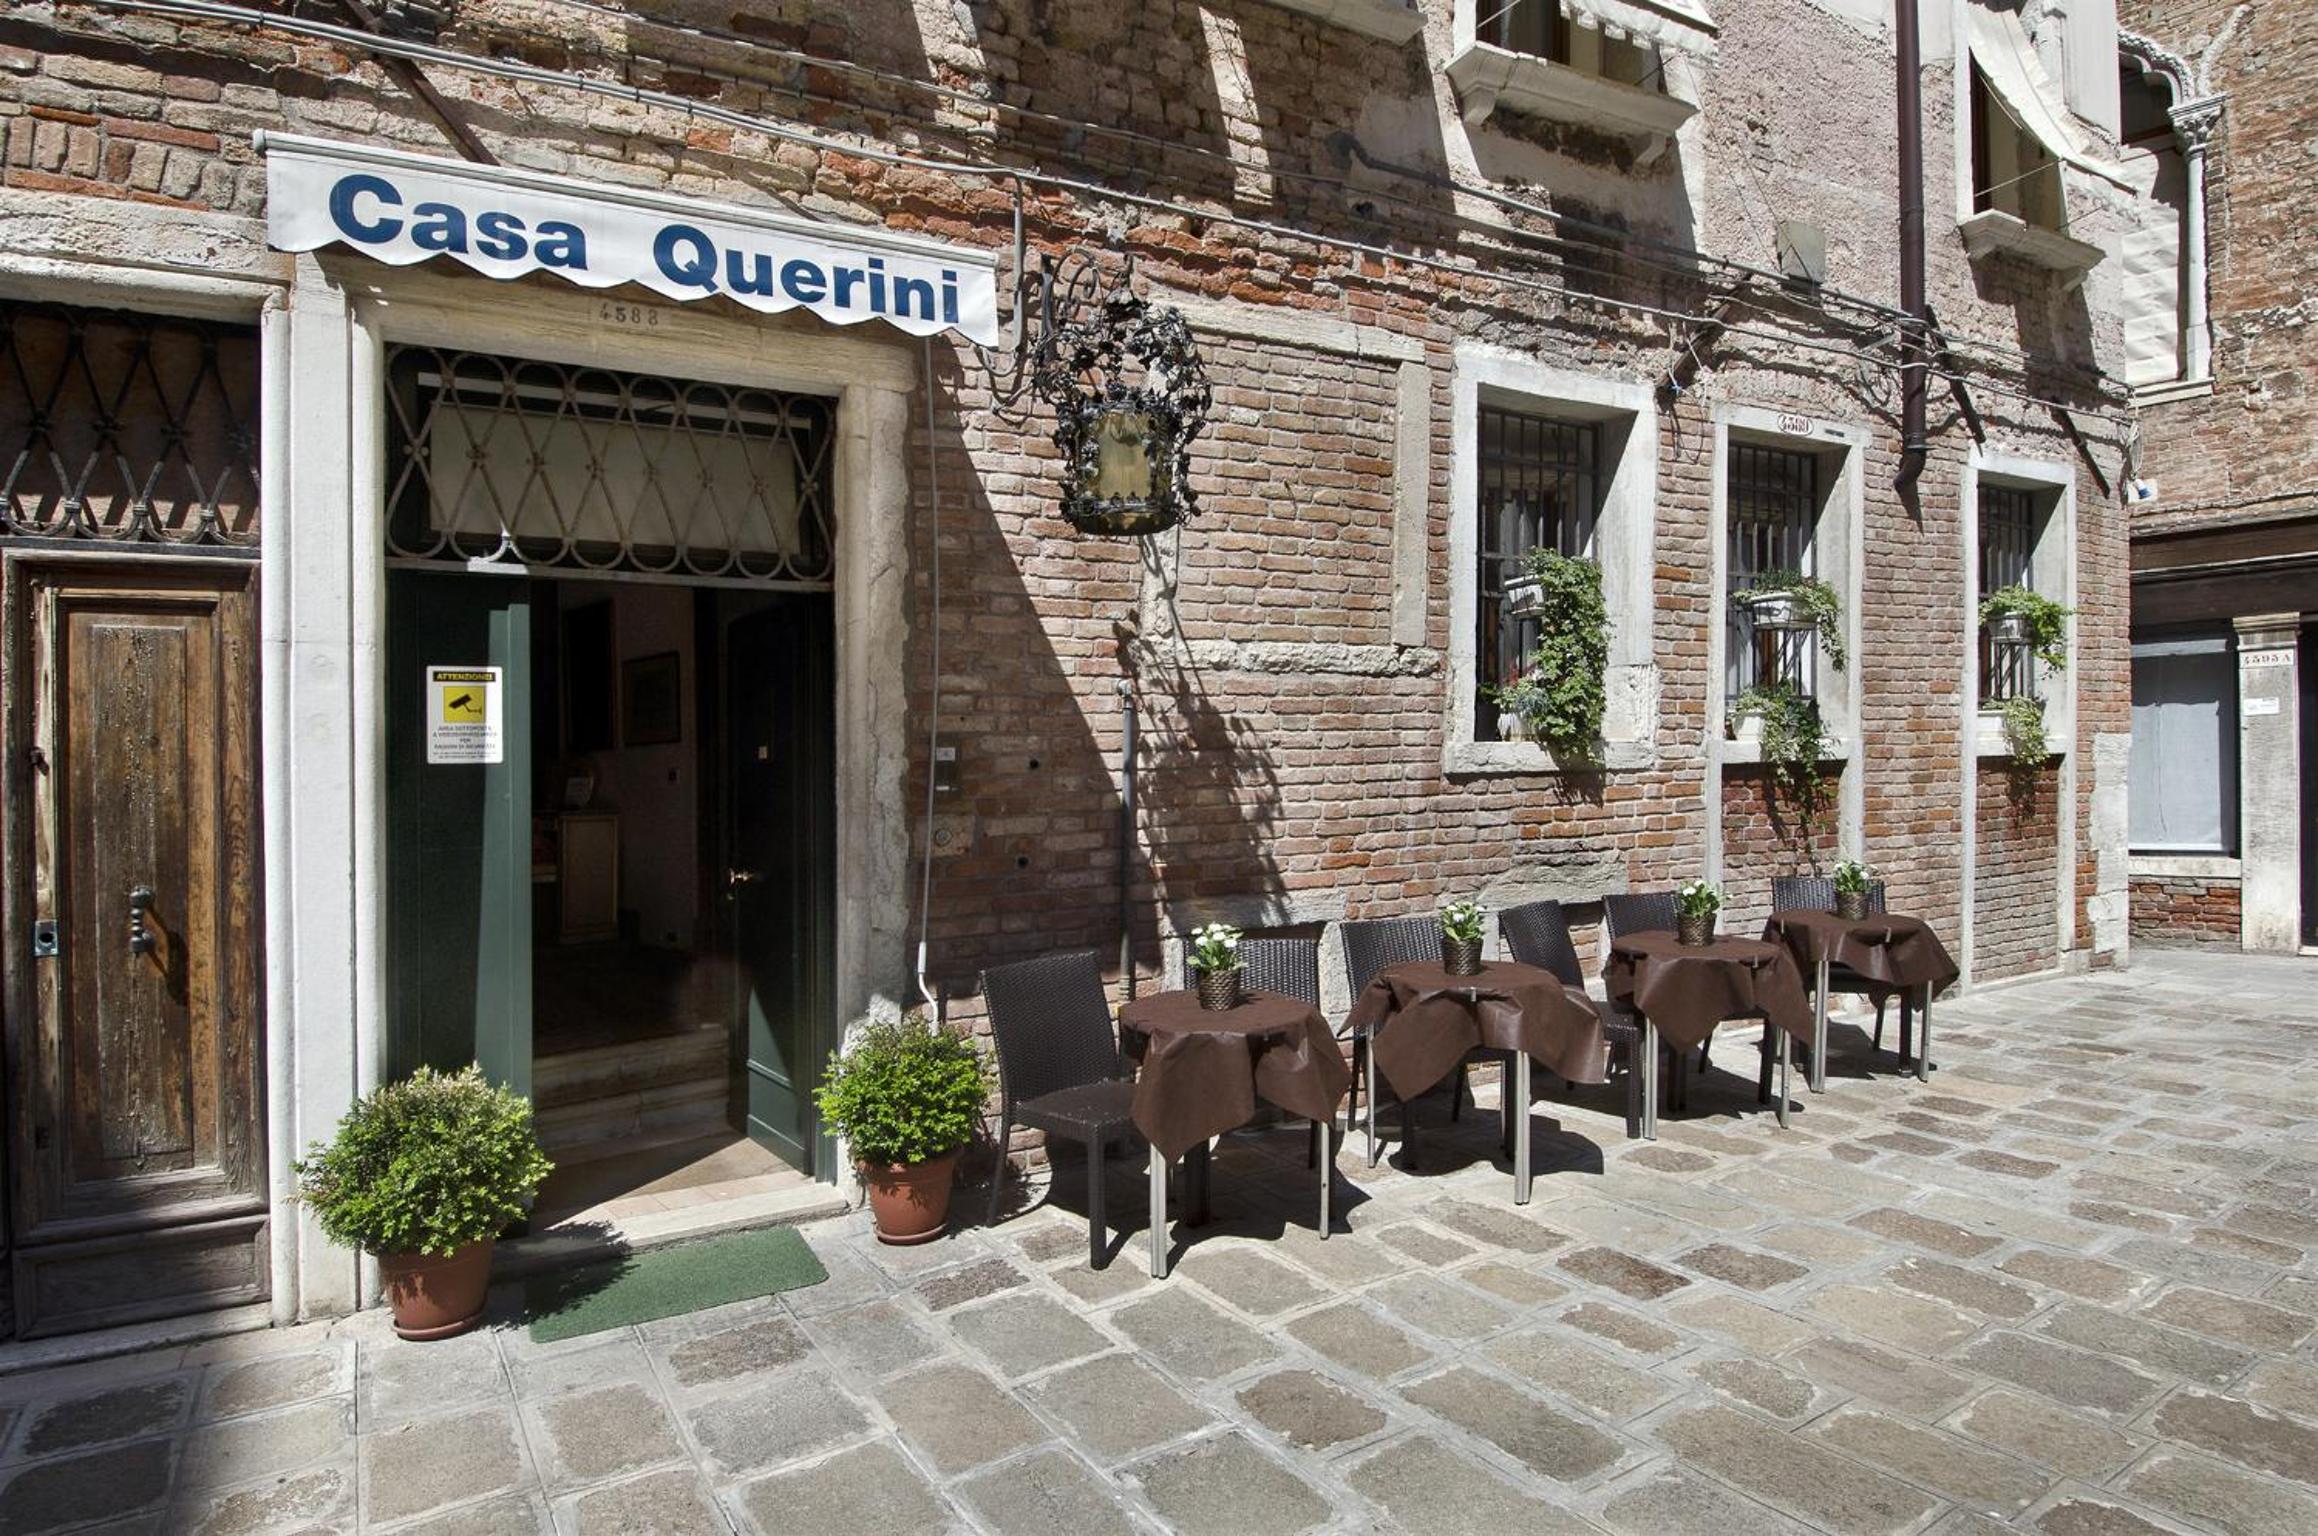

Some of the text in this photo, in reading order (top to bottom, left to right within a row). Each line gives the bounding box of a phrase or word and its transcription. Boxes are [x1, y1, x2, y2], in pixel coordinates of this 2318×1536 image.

[329, 174, 960, 325] Casa Querini
[599, 302, 659, 326] 4588
